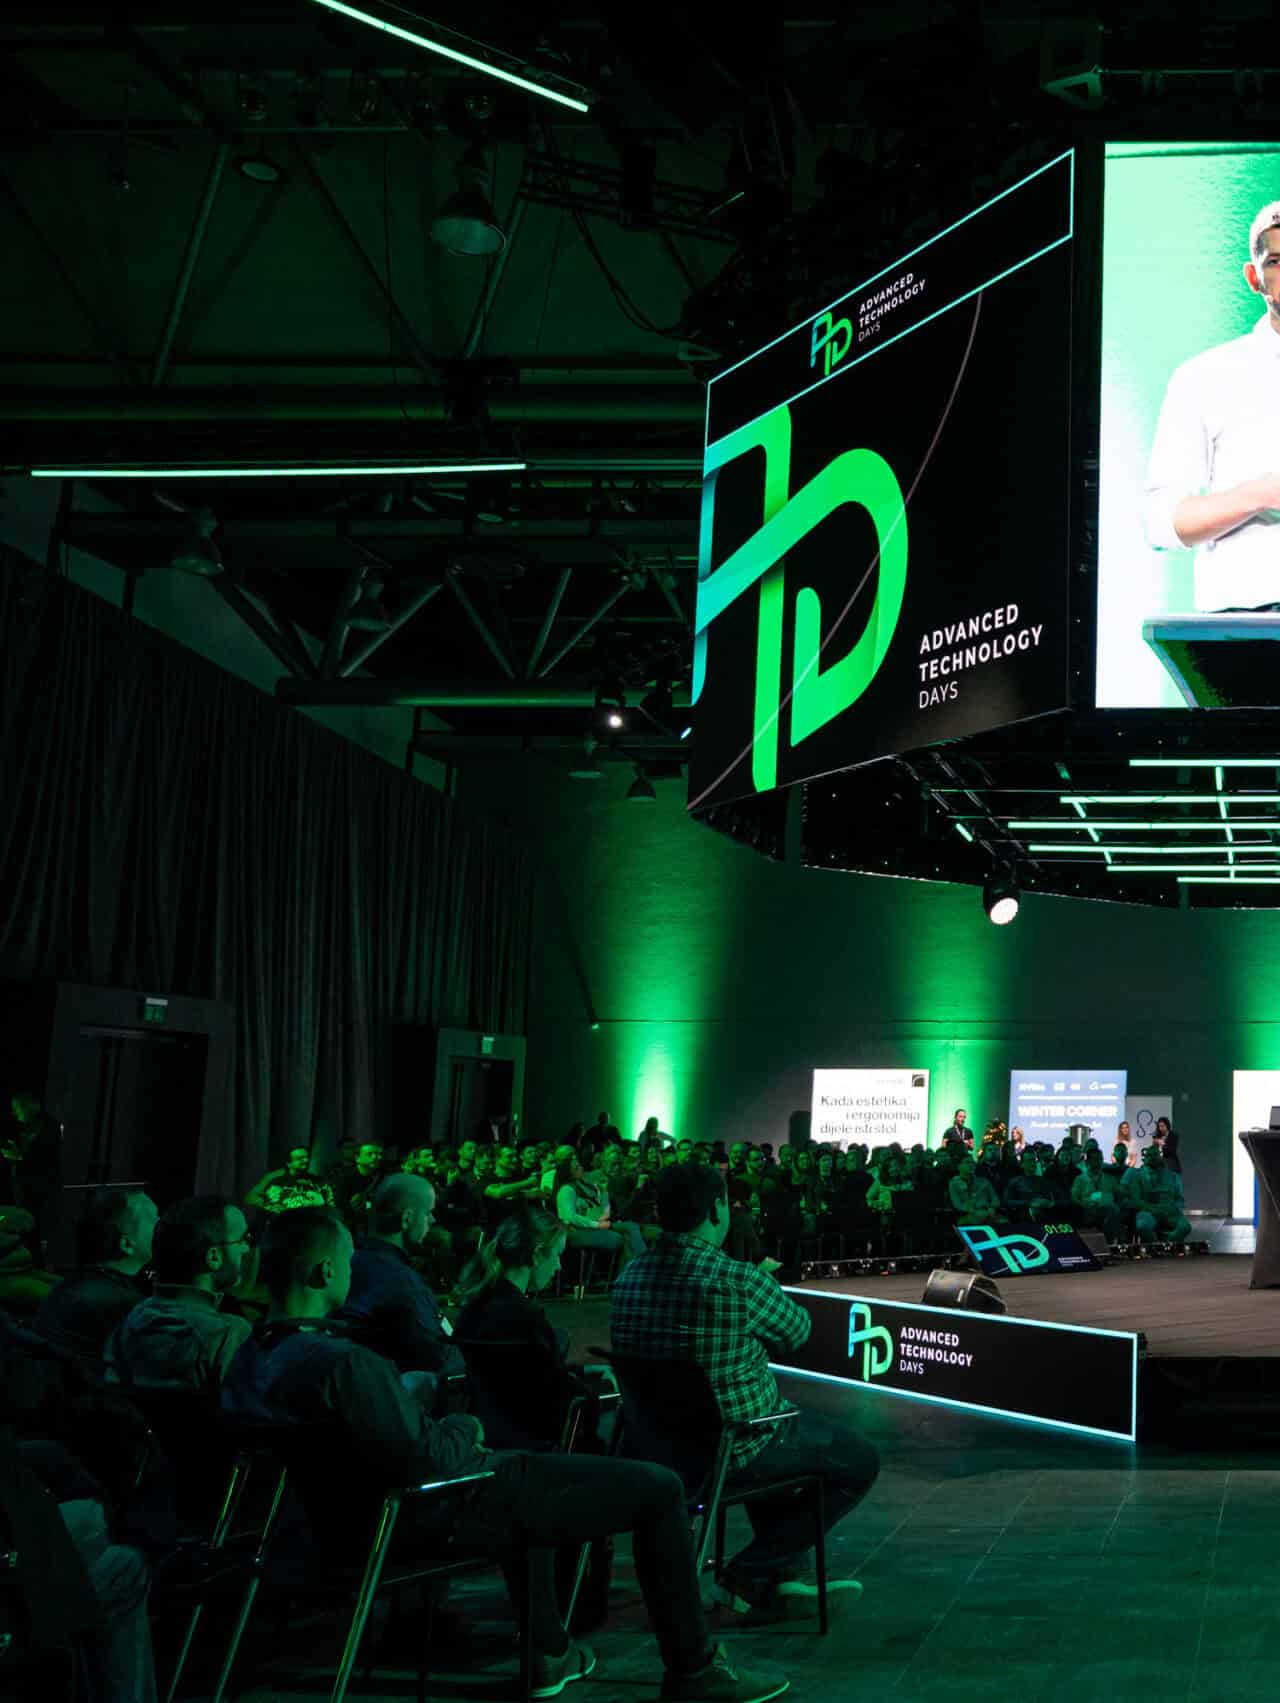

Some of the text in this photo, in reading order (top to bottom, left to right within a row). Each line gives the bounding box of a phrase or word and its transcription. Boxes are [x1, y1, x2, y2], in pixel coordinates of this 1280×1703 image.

[859, 273, 914, 314] ADVANCED
[859, 279, 926, 328] TECHNOLOGY
[858, 322, 881, 342] DAYS
[920, 603, 1019, 655] ADVANCED
[919, 624, 1043, 682] TECHNOLOGY
[919, 680, 959, 709] DAYS
[821, 1096, 907, 1106] Kada estetika
[900, 1327, 960, 1347] ADVANCED
[900, 1343, 973, 1367] TECHNOLOGY
[900, 1360, 925, 1375] DAYS
